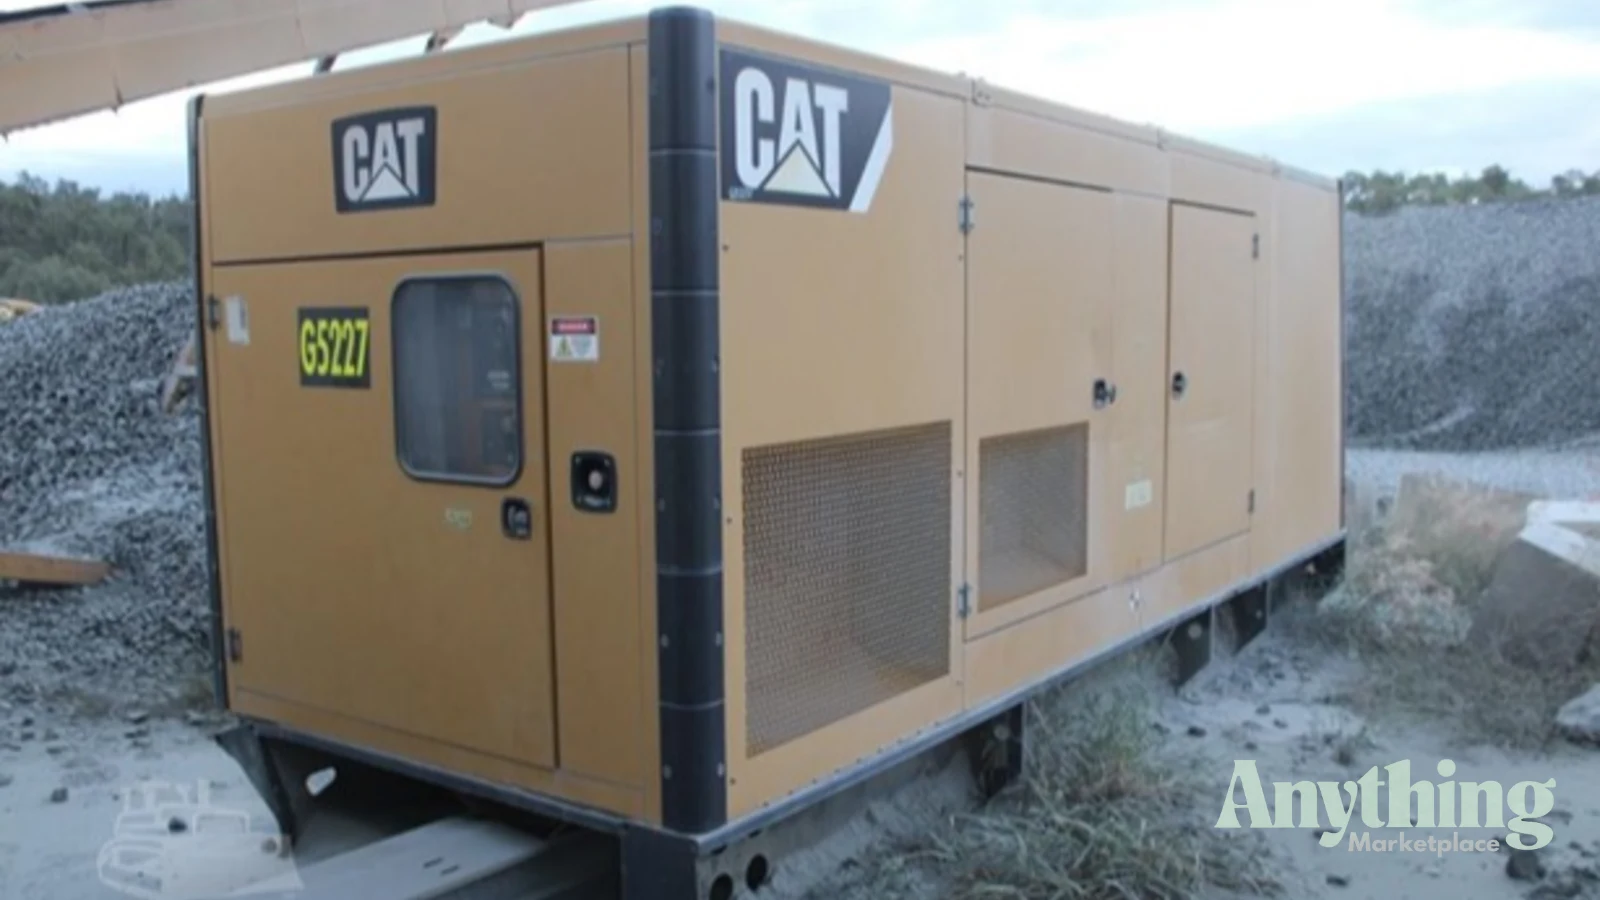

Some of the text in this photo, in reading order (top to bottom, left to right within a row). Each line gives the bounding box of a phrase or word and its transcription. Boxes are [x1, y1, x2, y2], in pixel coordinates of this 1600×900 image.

[342, 117, 425, 203] CAT
[734, 67, 848, 199] CAT
[301, 318, 368, 377] G5227
